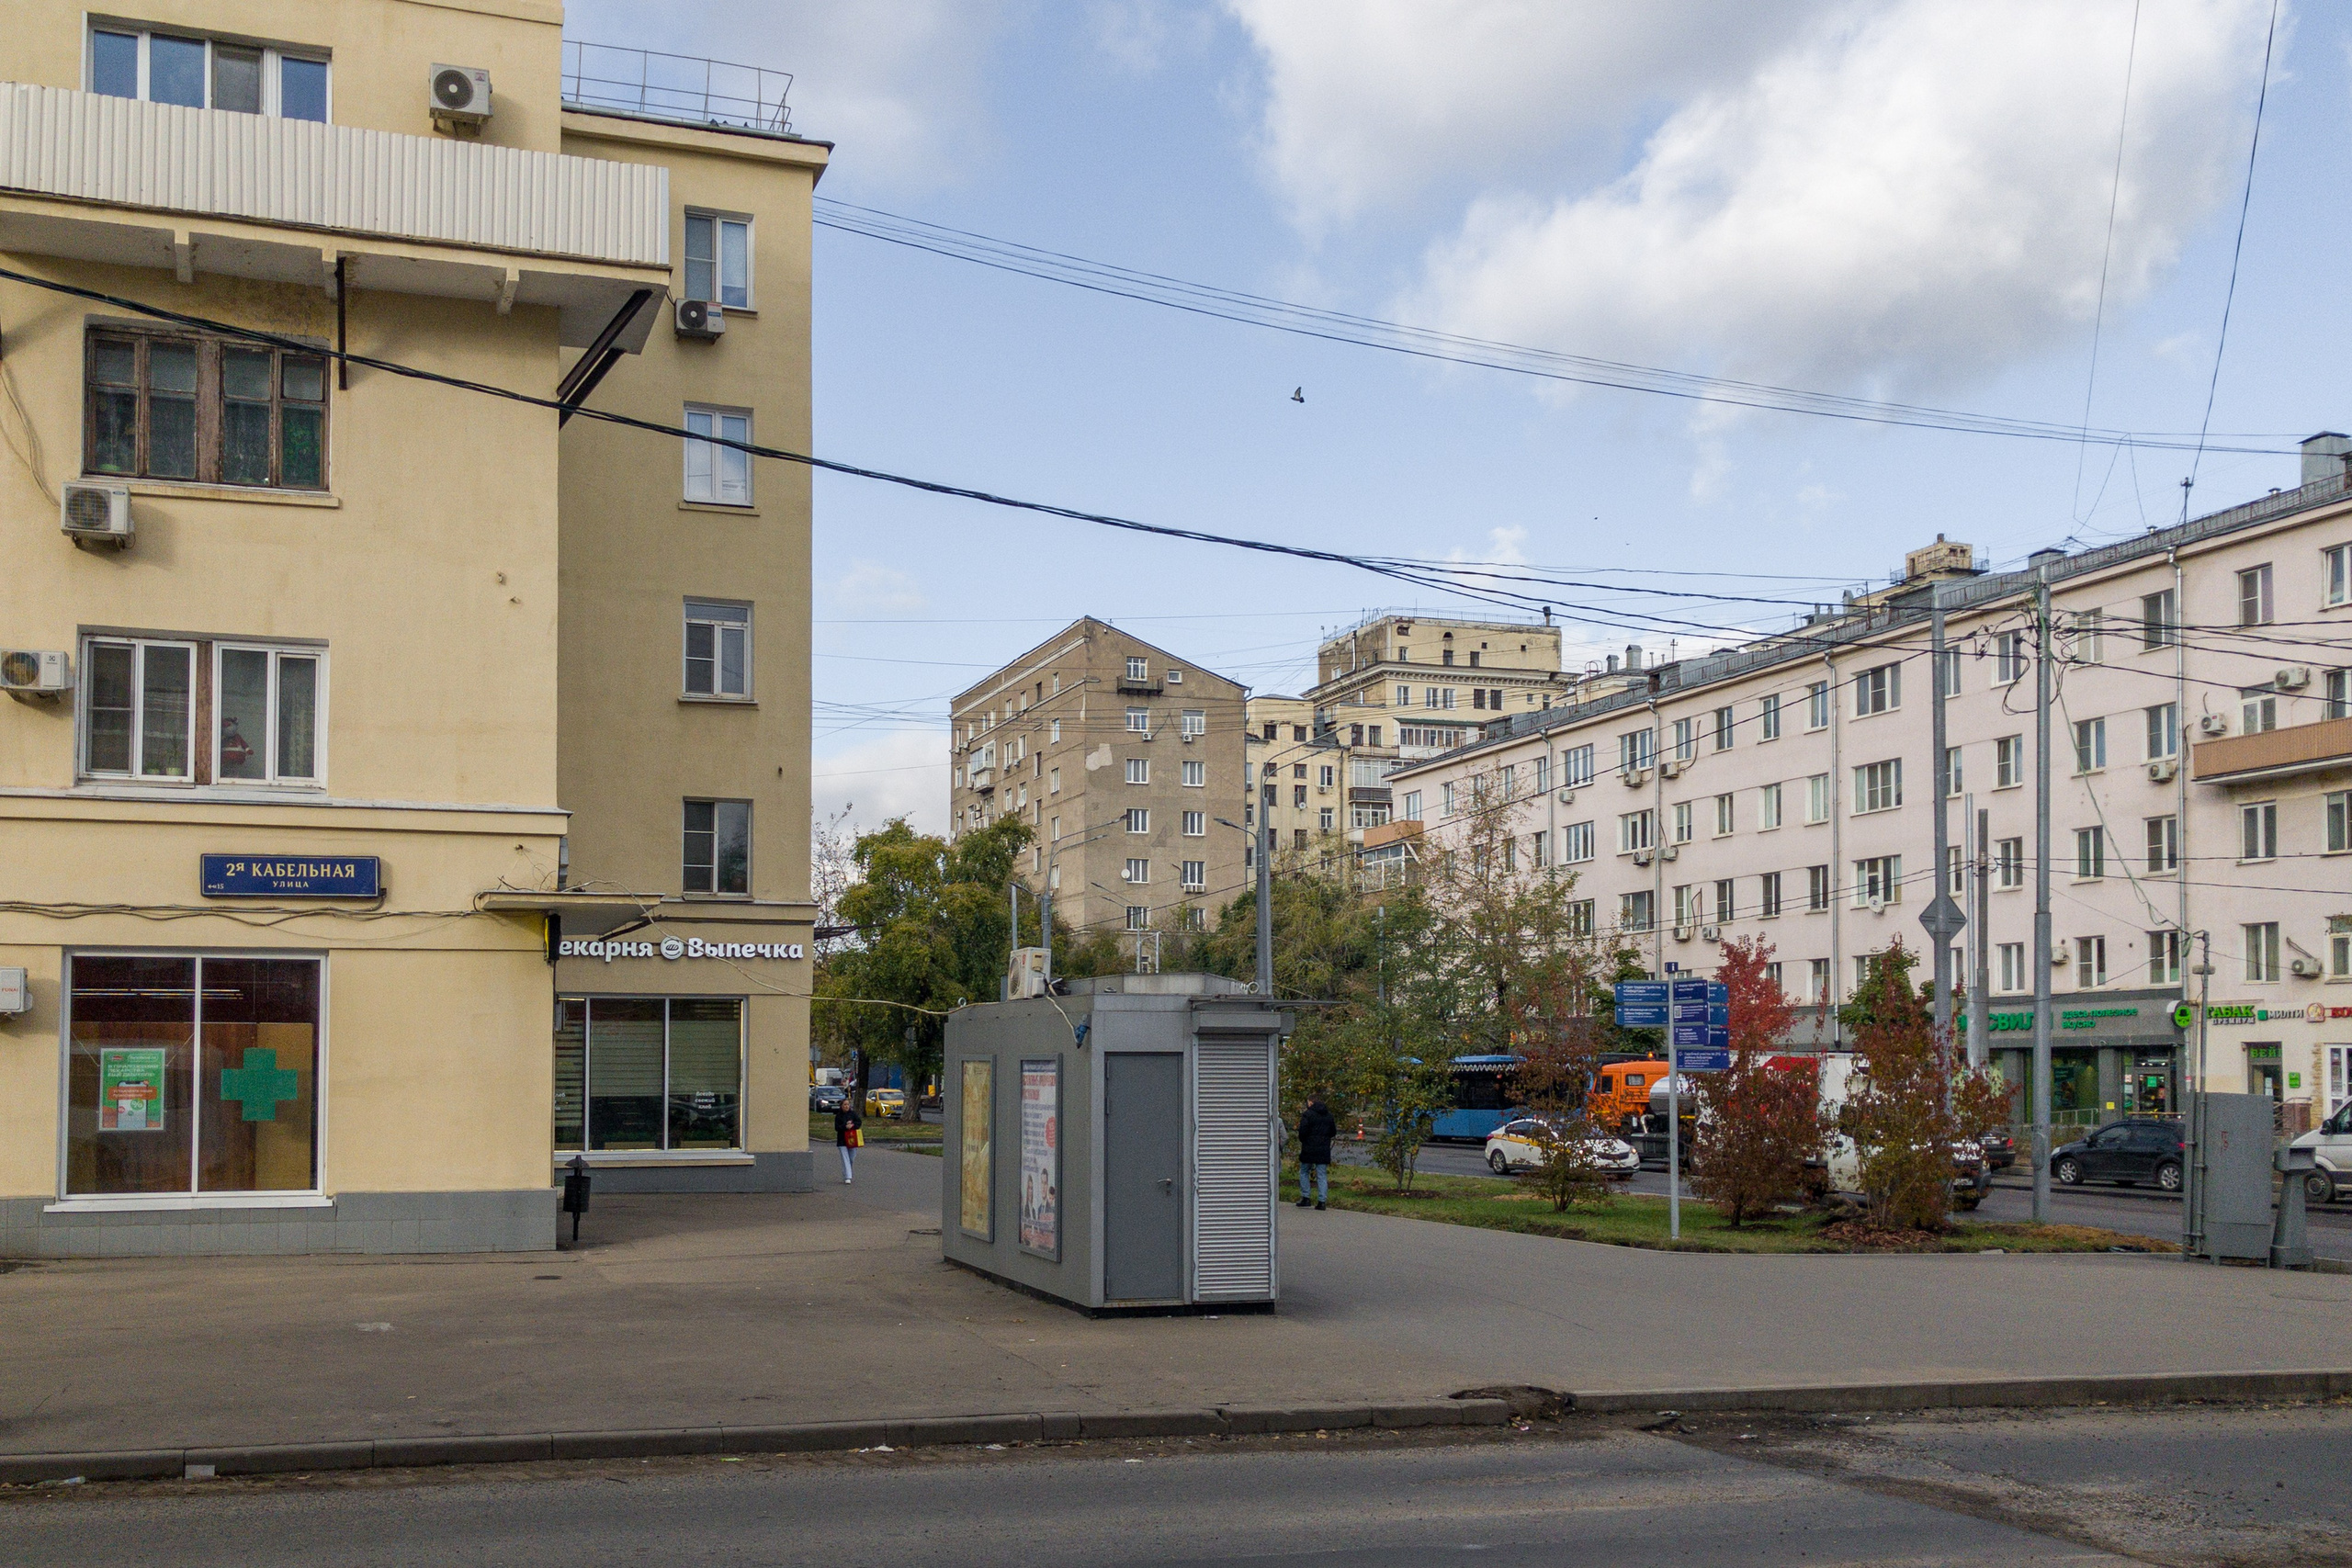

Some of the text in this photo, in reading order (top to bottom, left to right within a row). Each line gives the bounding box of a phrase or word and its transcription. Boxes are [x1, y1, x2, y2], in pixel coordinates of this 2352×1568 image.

[252, 863, 356, 878] КАБЕЛЬНАЯ
[272, 880, 310, 888] УЛИЦА
[559, 937, 805, 963] екарня Выпечка
[2062, 1008, 2138, 1019] здесь полезное
[2062, 1019, 2096, 1031] вкусно
